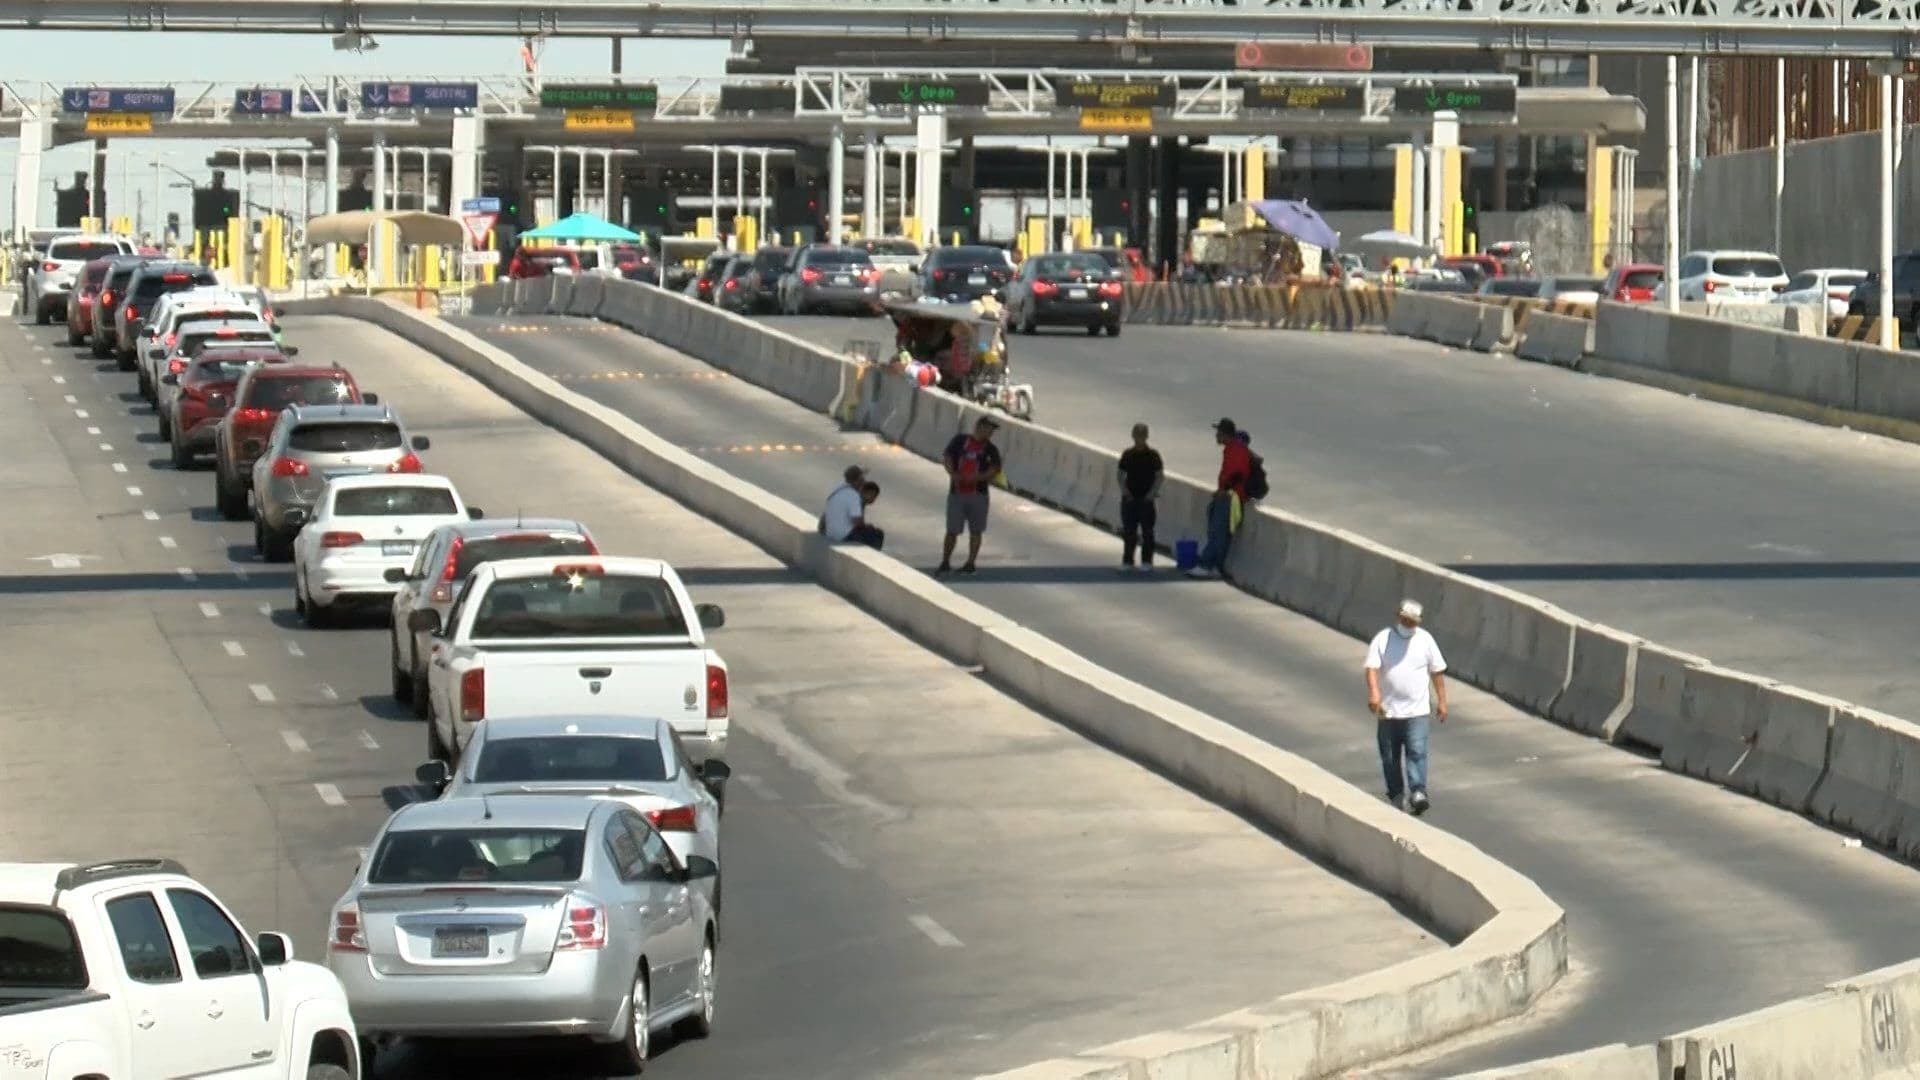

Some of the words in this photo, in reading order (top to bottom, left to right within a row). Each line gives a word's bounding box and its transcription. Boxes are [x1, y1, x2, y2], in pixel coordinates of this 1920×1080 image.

[920, 84, 955, 100] Open
[1871, 992, 1898, 1052] GH
[1708, 1043, 1738, 1080] GH
